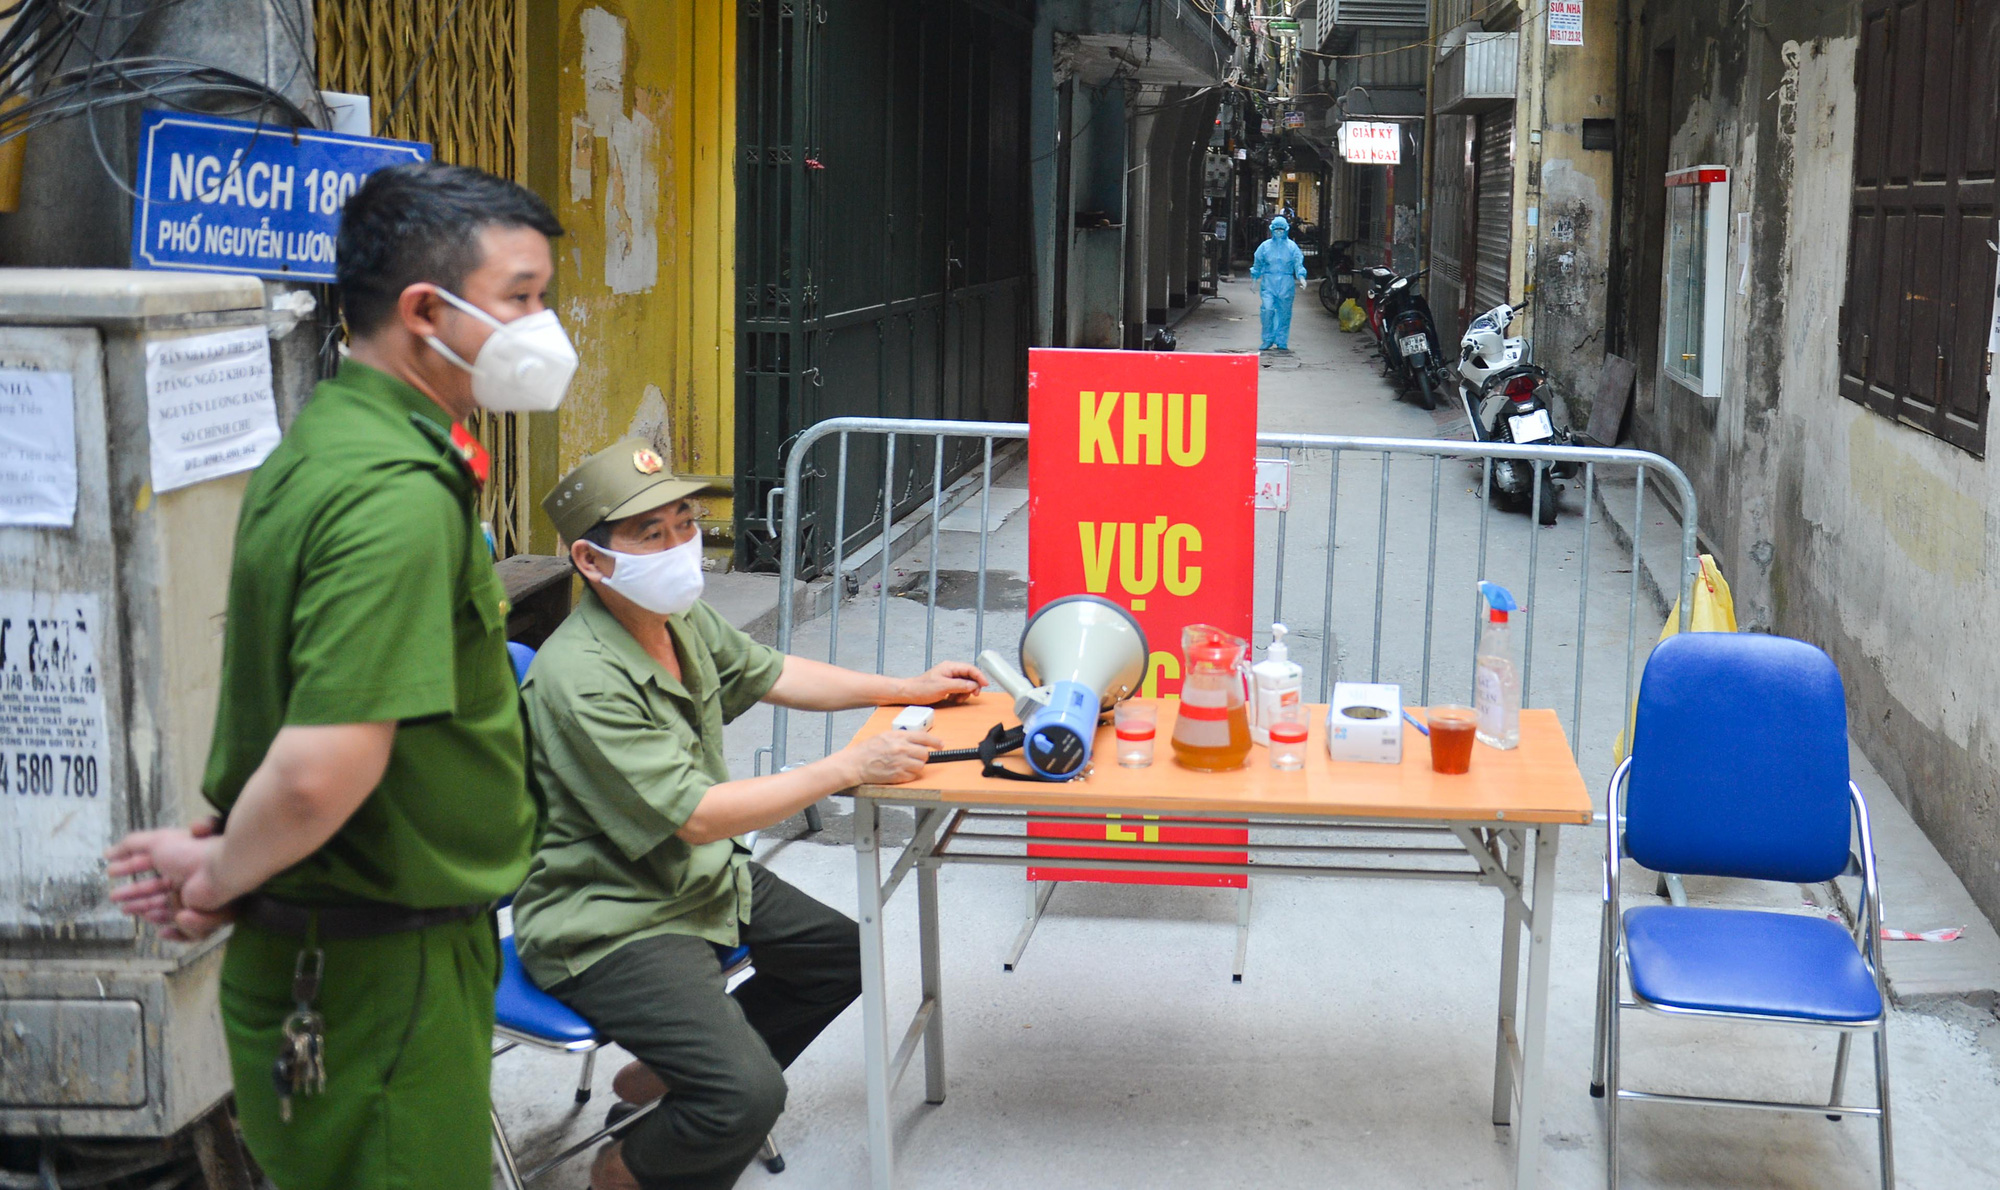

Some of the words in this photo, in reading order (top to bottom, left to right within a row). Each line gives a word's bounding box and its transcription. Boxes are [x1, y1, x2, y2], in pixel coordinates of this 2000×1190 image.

[168, 148, 295, 210] NGÁCH
[158, 213, 203, 253] PHỐ
[204, 216, 285, 259] NGUYỄN
[286, 230, 337, 263] LƯƠN
[226, 367, 247, 381] KHO
[1078, 390, 1208, 468] KHU
[1077, 516, 1203, 612] VỰC
[16, 753, 53, 796] 580
[60, 754, 98, 798] 780
